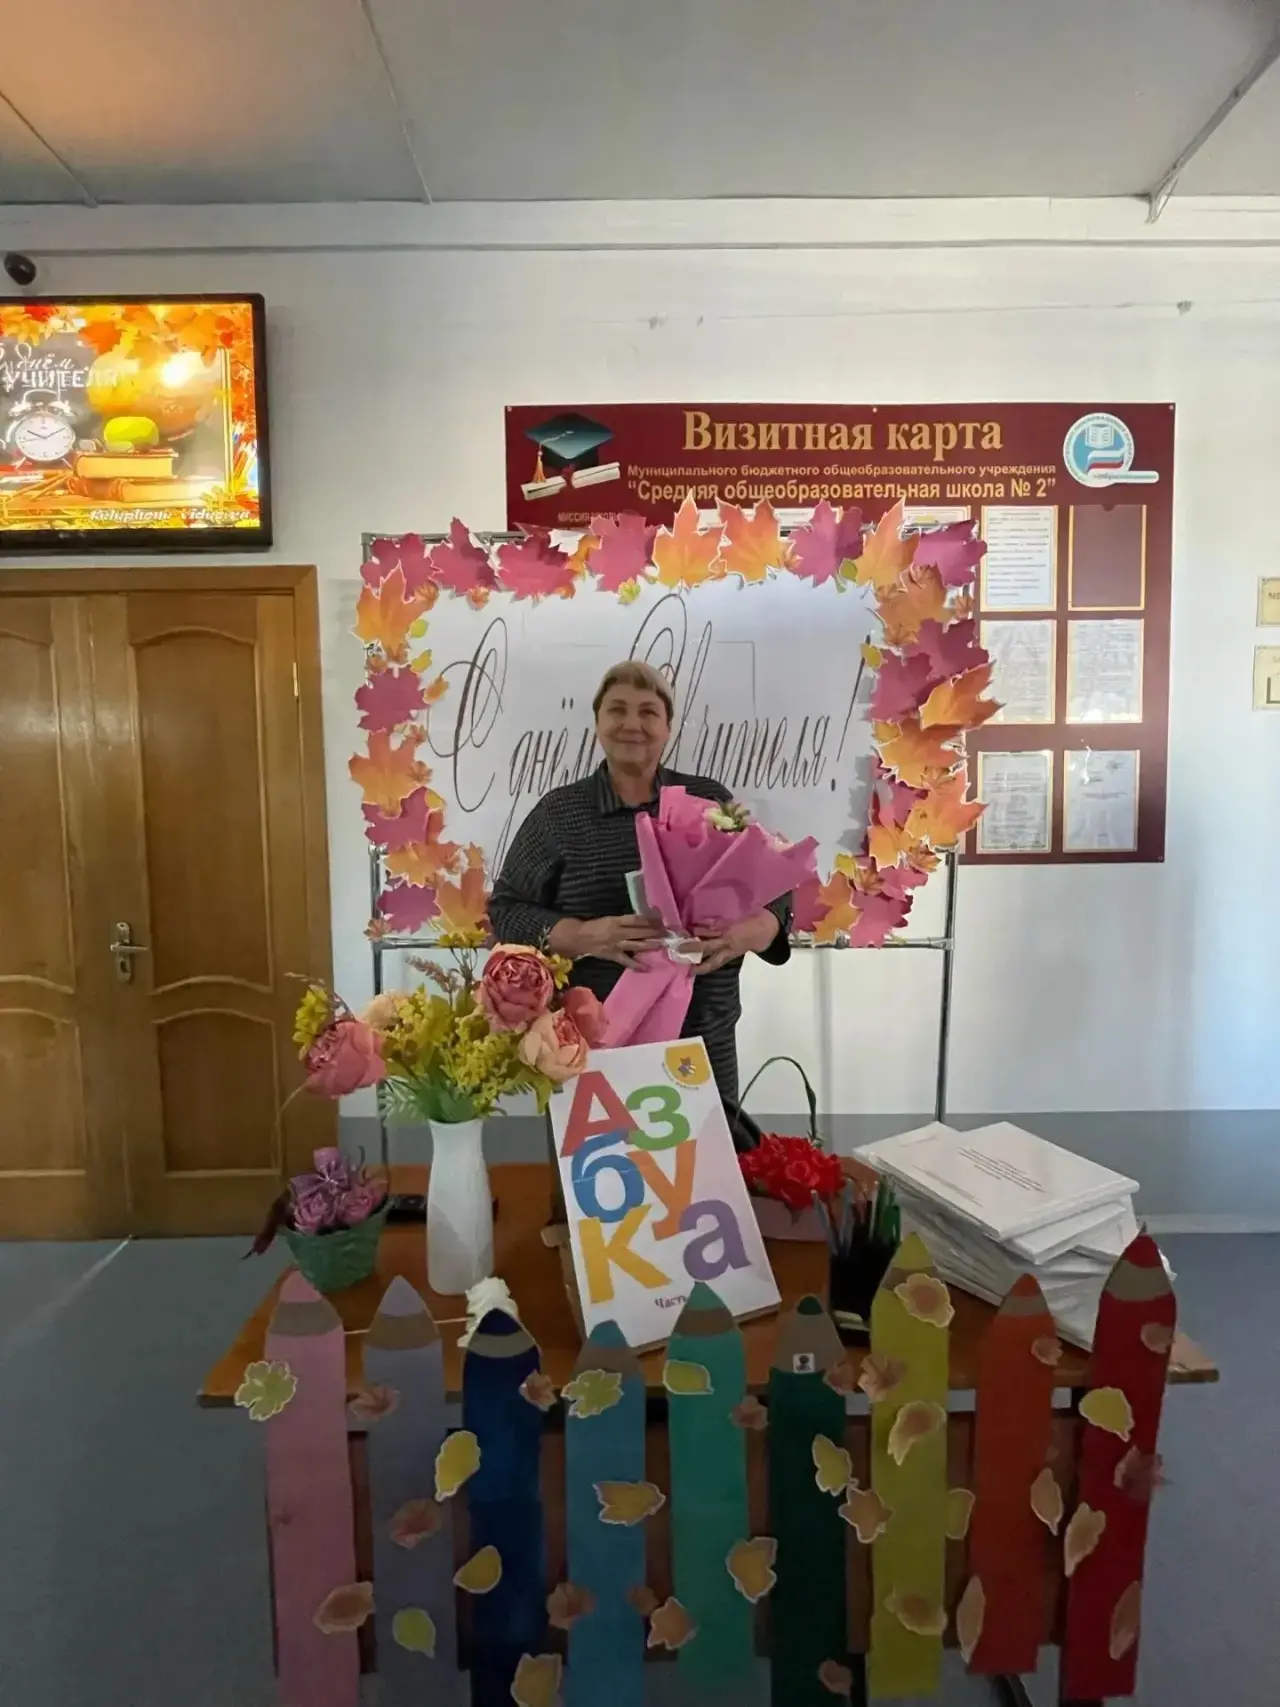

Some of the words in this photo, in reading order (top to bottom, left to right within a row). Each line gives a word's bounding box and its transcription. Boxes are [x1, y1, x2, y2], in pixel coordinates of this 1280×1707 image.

[682, 410, 874, 451] Визитная
[887, 421, 1003, 462] карта
[627, 464, 737, 479] Муниципального
[741, 464, 820, 477] бюджетного
[823, 464, 976, 478] общеобразовательного
[979, 464, 1056, 478] учреждения
[724, 479, 940, 503] общеобразовательная
[946, 480, 1005, 499] школа
[426, 617, 507, 812] С
